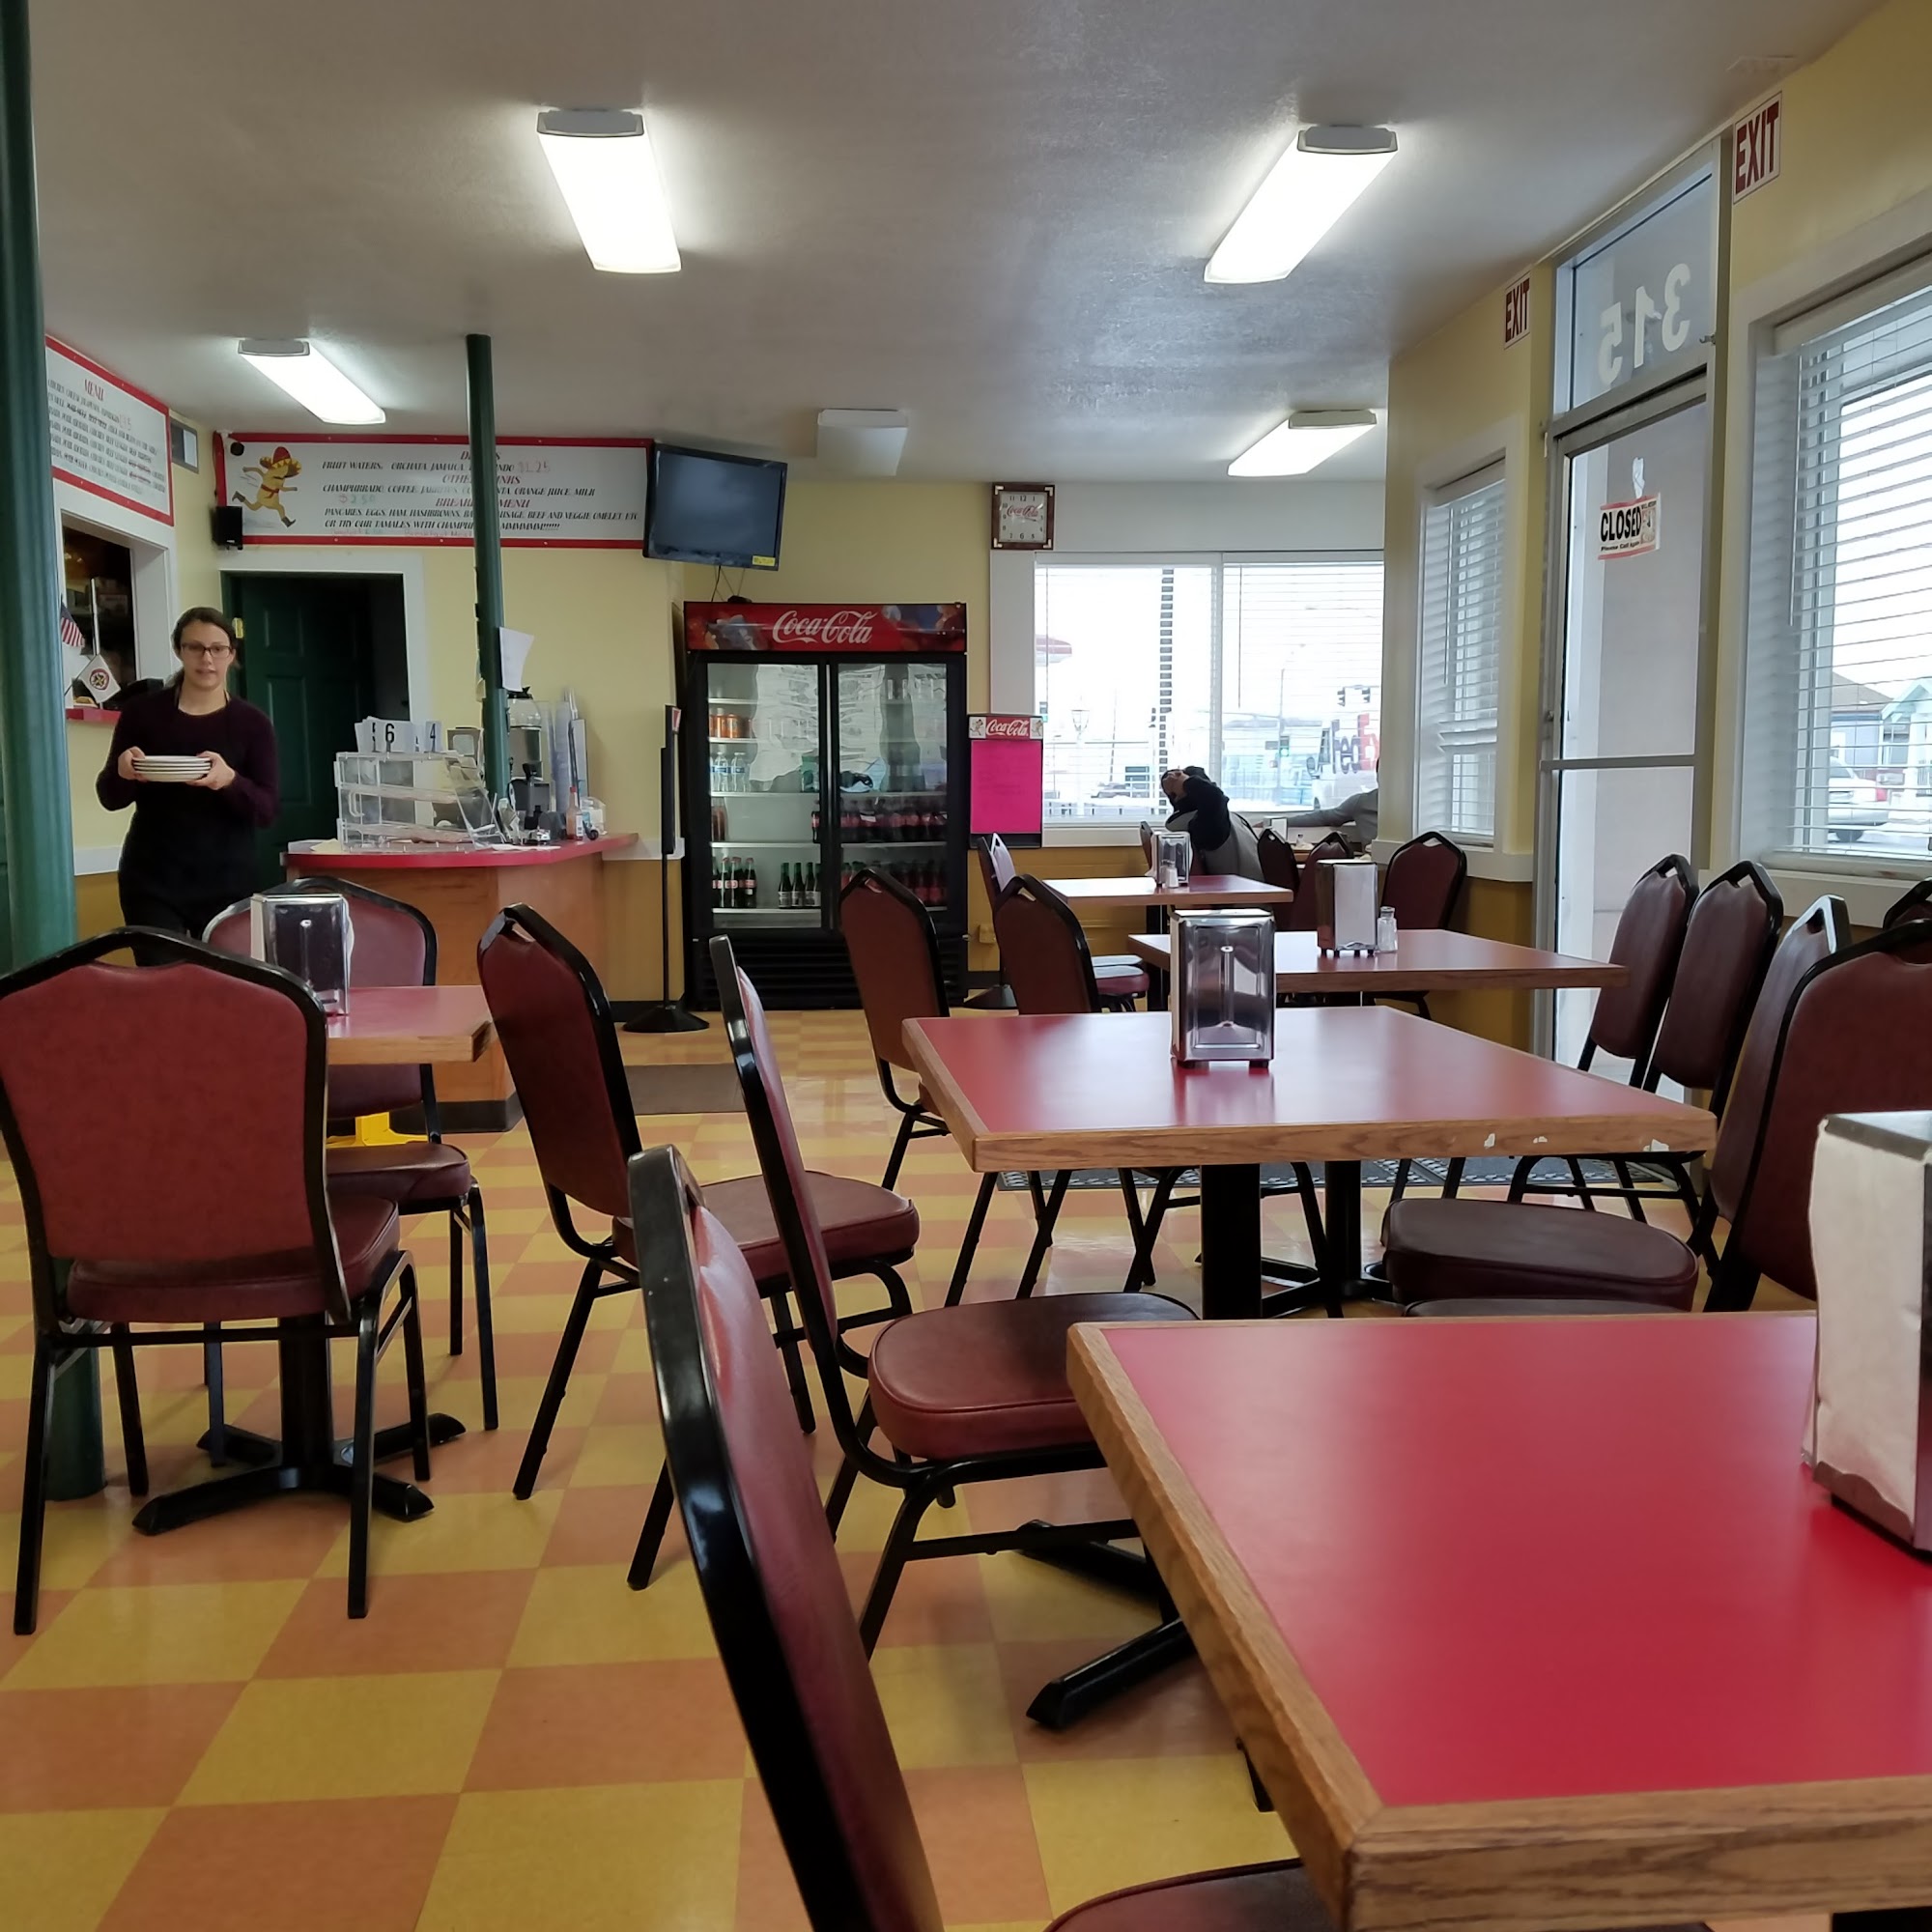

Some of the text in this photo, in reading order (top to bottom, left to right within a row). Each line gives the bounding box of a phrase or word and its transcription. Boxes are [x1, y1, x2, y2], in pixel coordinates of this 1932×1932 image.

[1735, 100, 1779, 195] EXIT
[1505, 277, 1530, 343] EXIT
[322, 461, 347, 469] FRUIT
[442, 474, 471, 484] OTHE
[1601, 506, 1642, 542] CLOSED
[773, 610, 878, 644] Coca-Cola
[385, 723, 395, 744] 6
[429, 723, 436, 744] 4
[986, 719, 1029, 737] Coca-Cola
